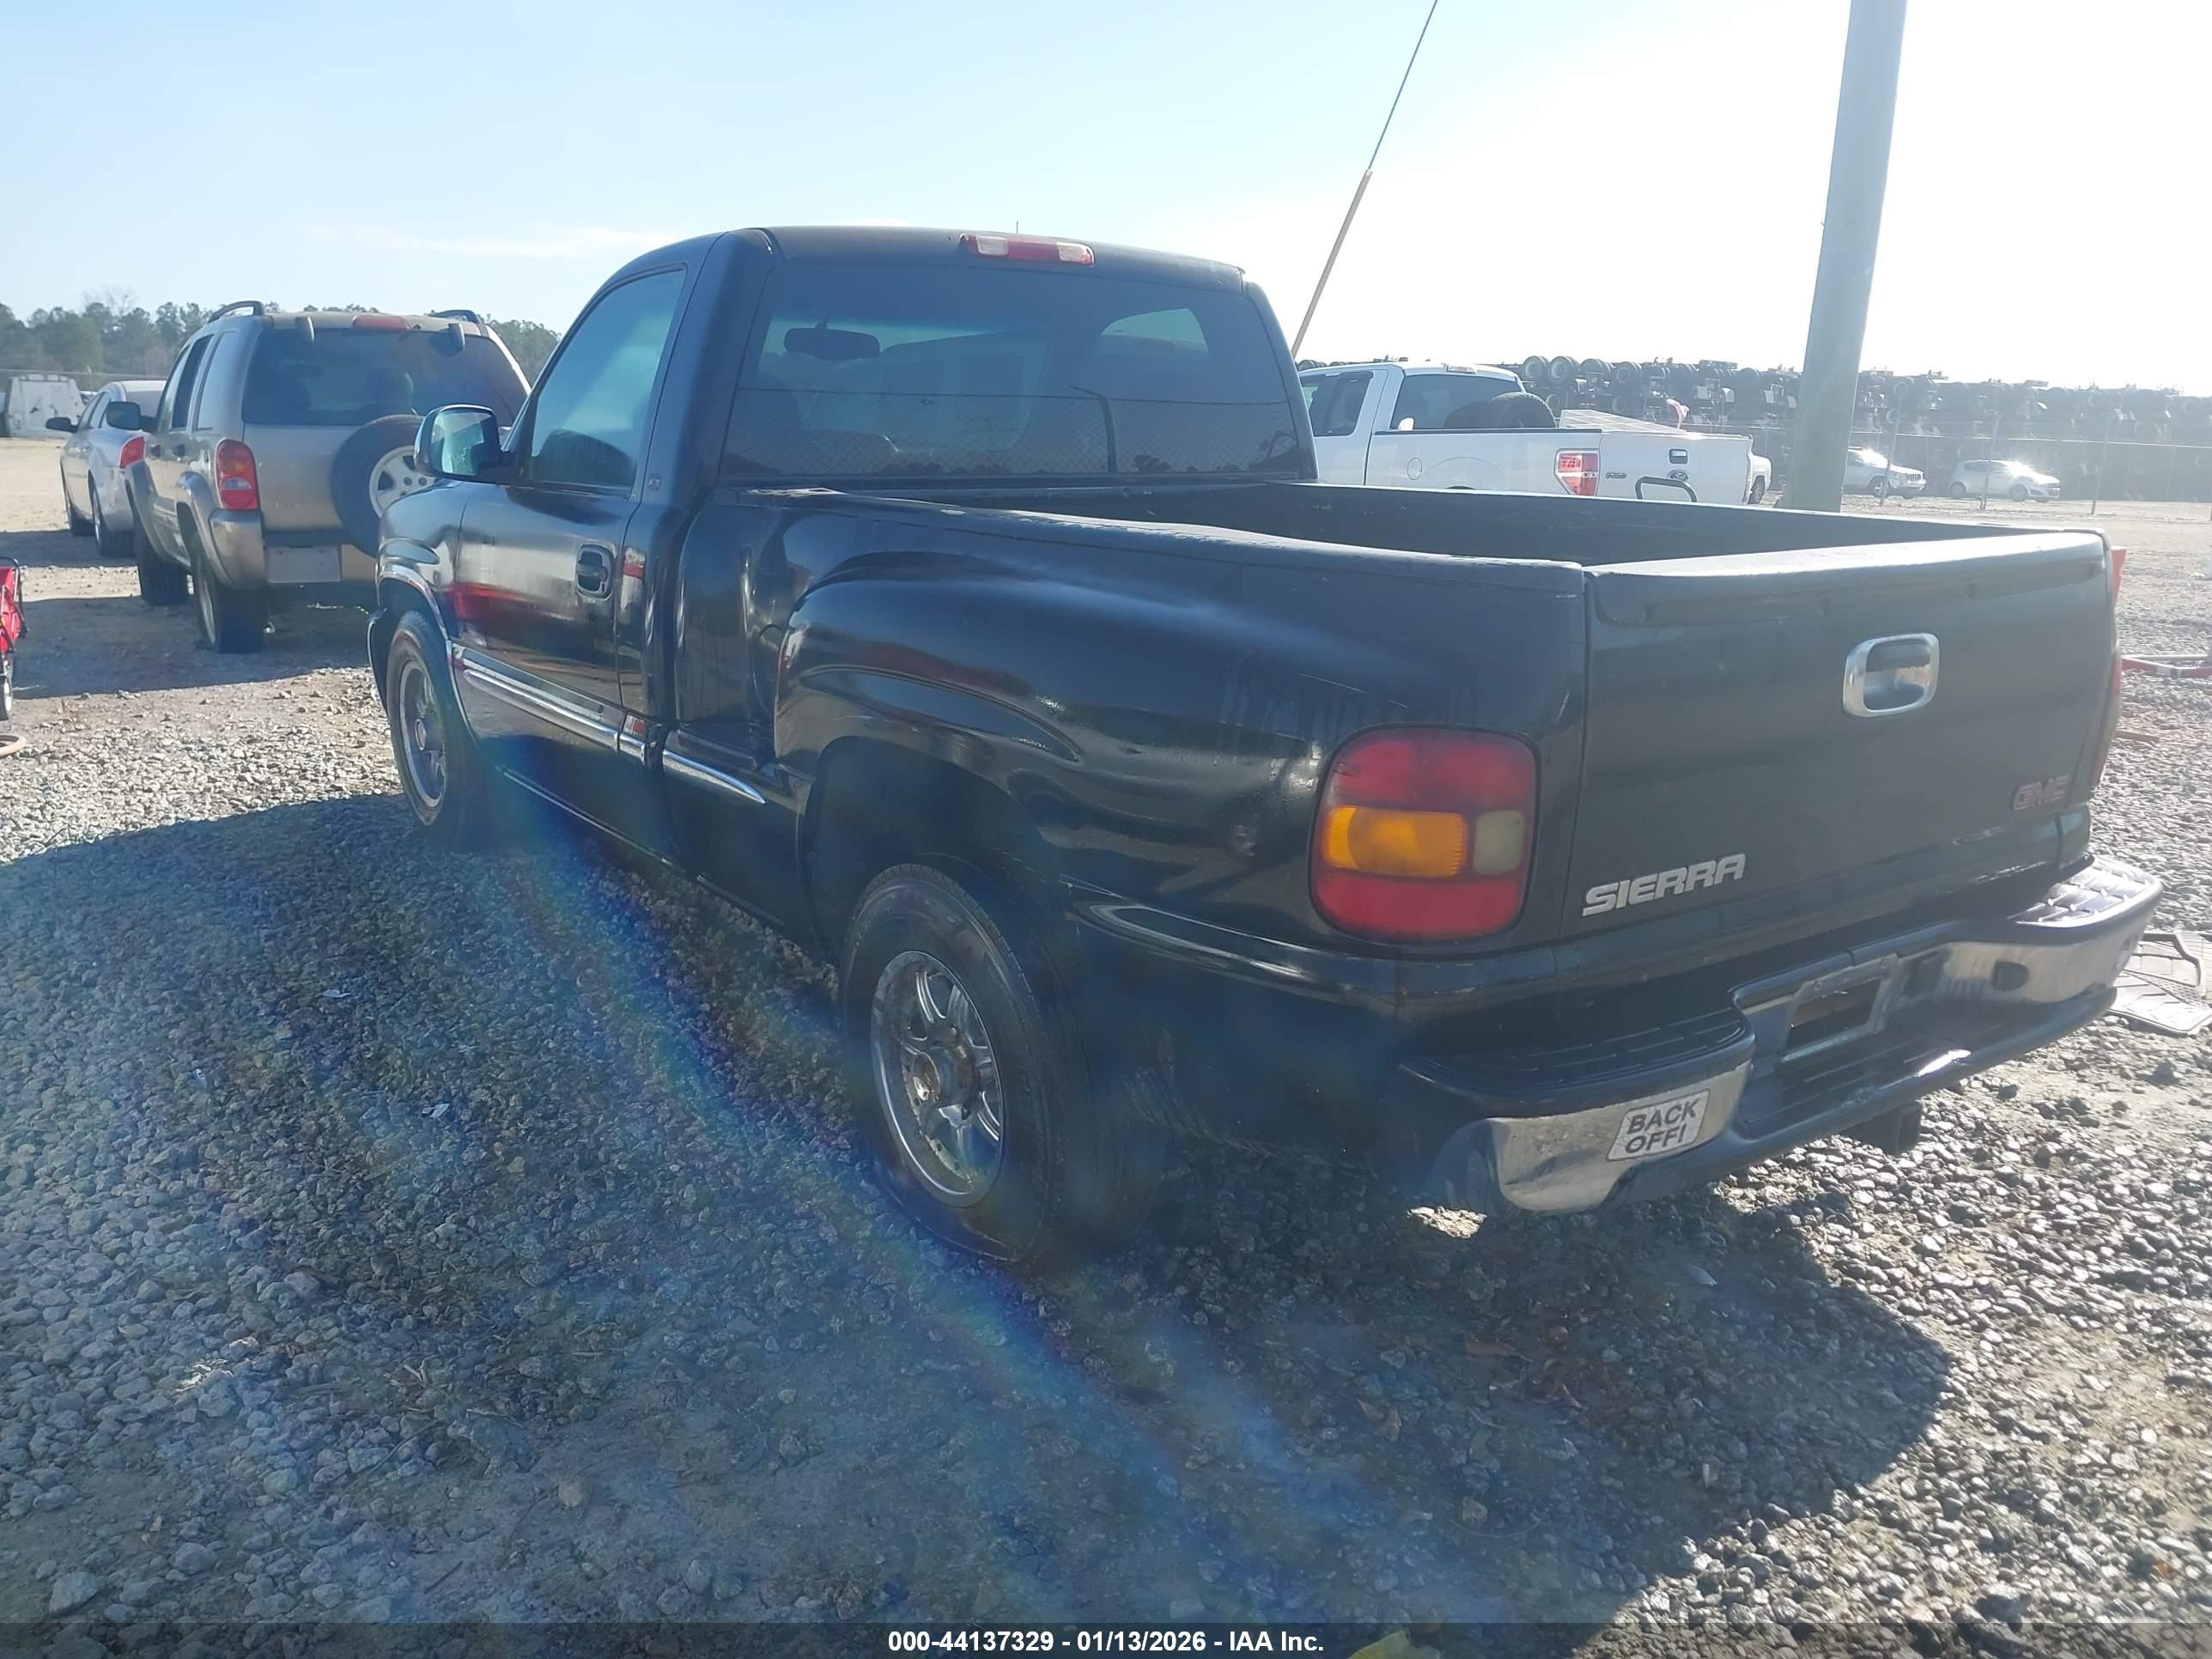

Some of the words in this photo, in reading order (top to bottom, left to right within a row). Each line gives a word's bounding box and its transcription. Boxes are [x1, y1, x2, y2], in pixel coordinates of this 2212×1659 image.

[2014, 775, 2069, 811] GMC
[1582, 853, 1747, 917] SIERRA
[1627, 1097, 1702, 1135] BACK
